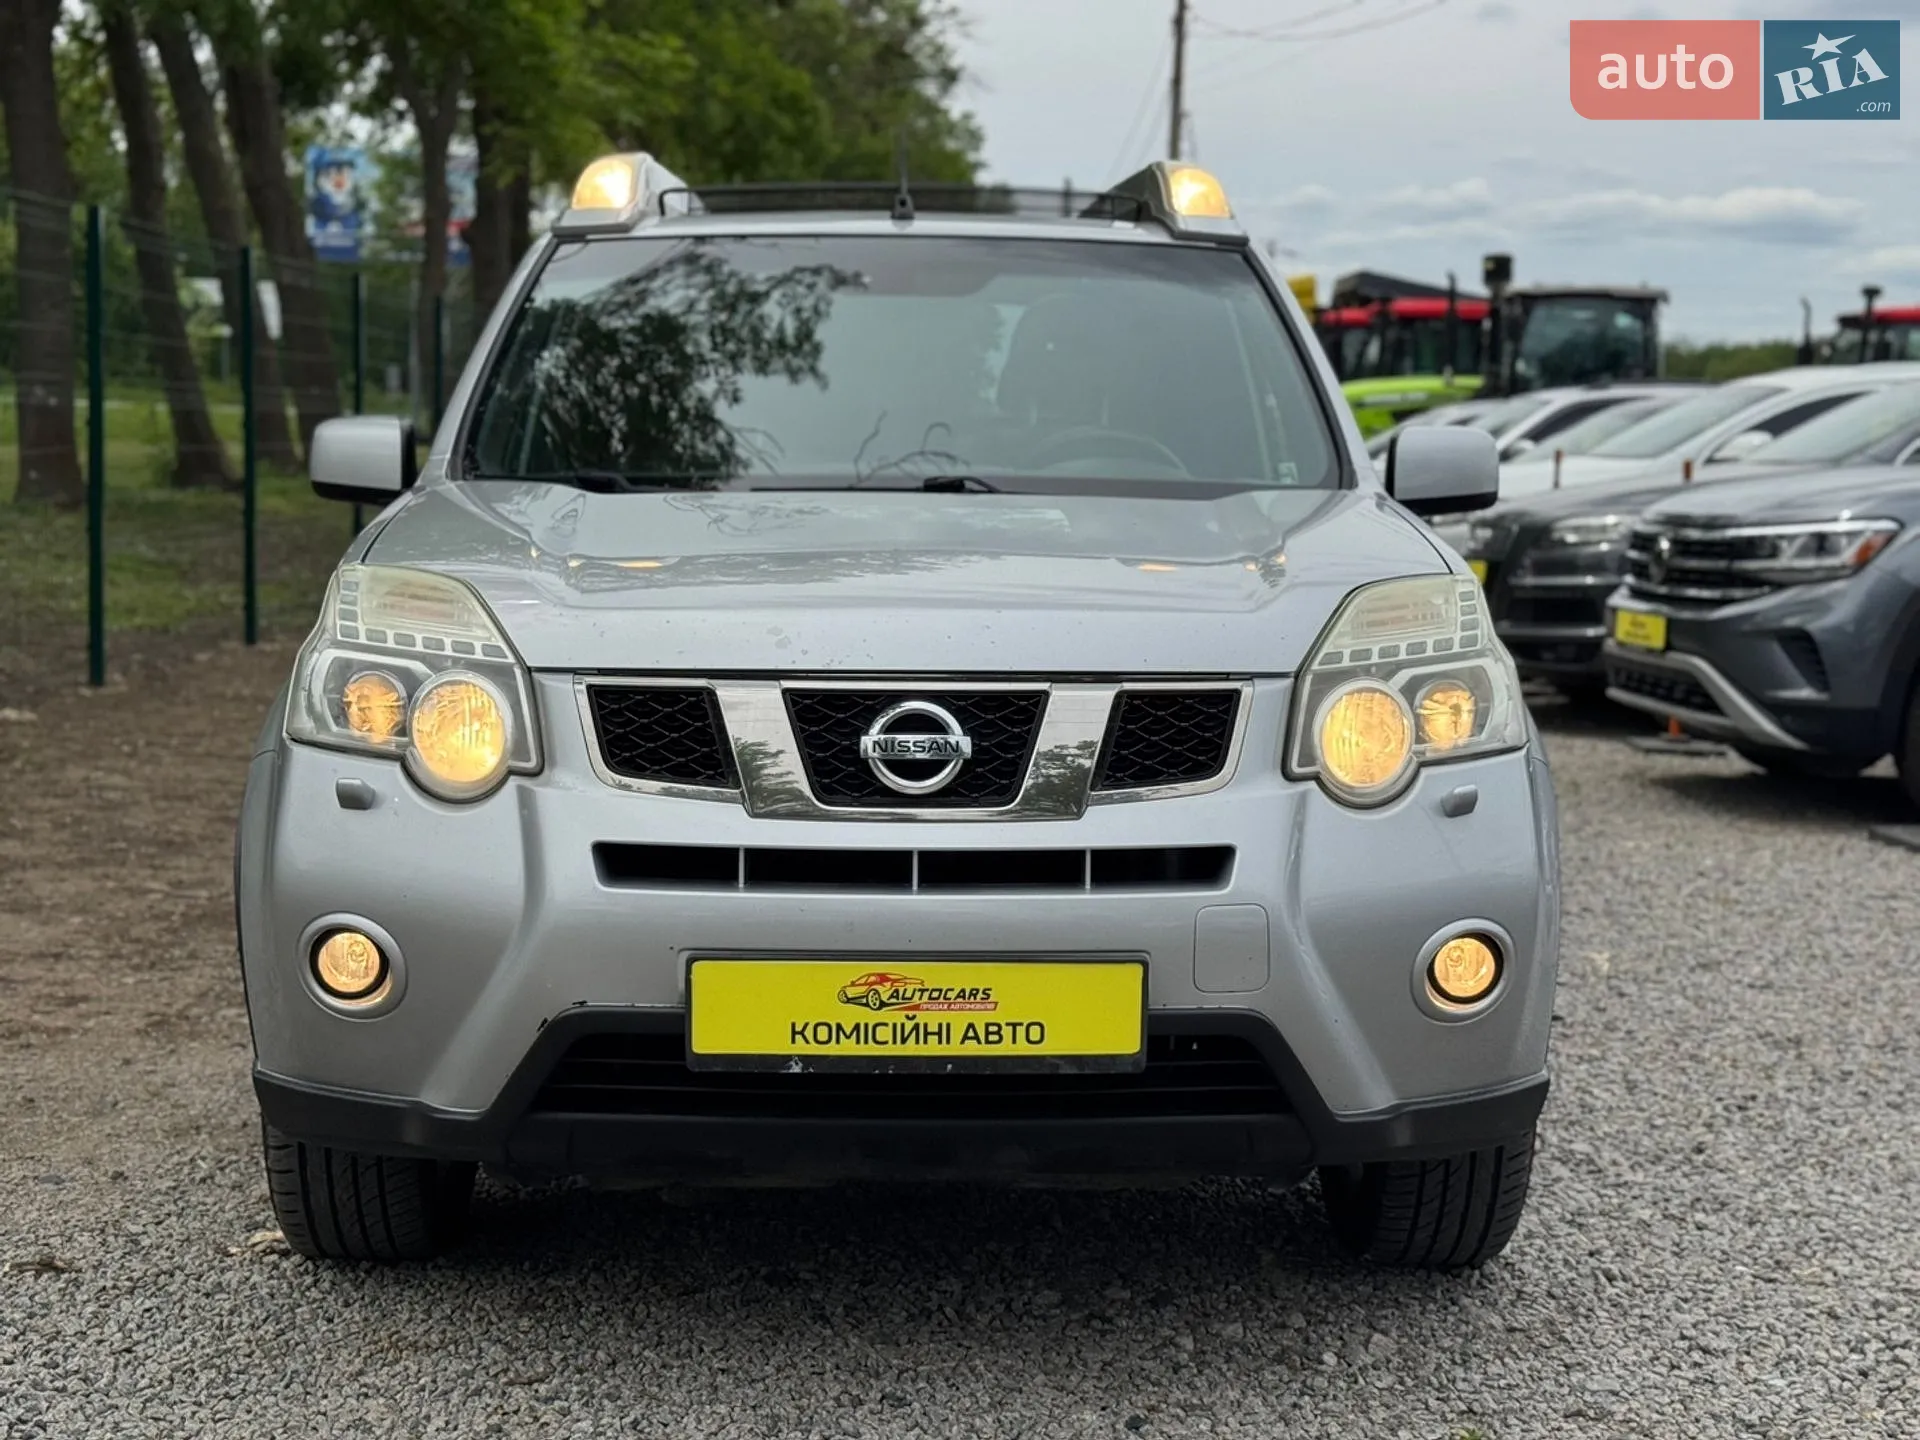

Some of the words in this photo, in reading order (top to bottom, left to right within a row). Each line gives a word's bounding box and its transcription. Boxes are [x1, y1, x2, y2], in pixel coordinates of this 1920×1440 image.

[872, 740, 960, 753] NISSAN
[887, 988, 993, 1001] AUTOCARS
[790, 1014, 951, 1046] КОМІСІЙНІ
[960, 1021, 1046, 1046] АВТО
